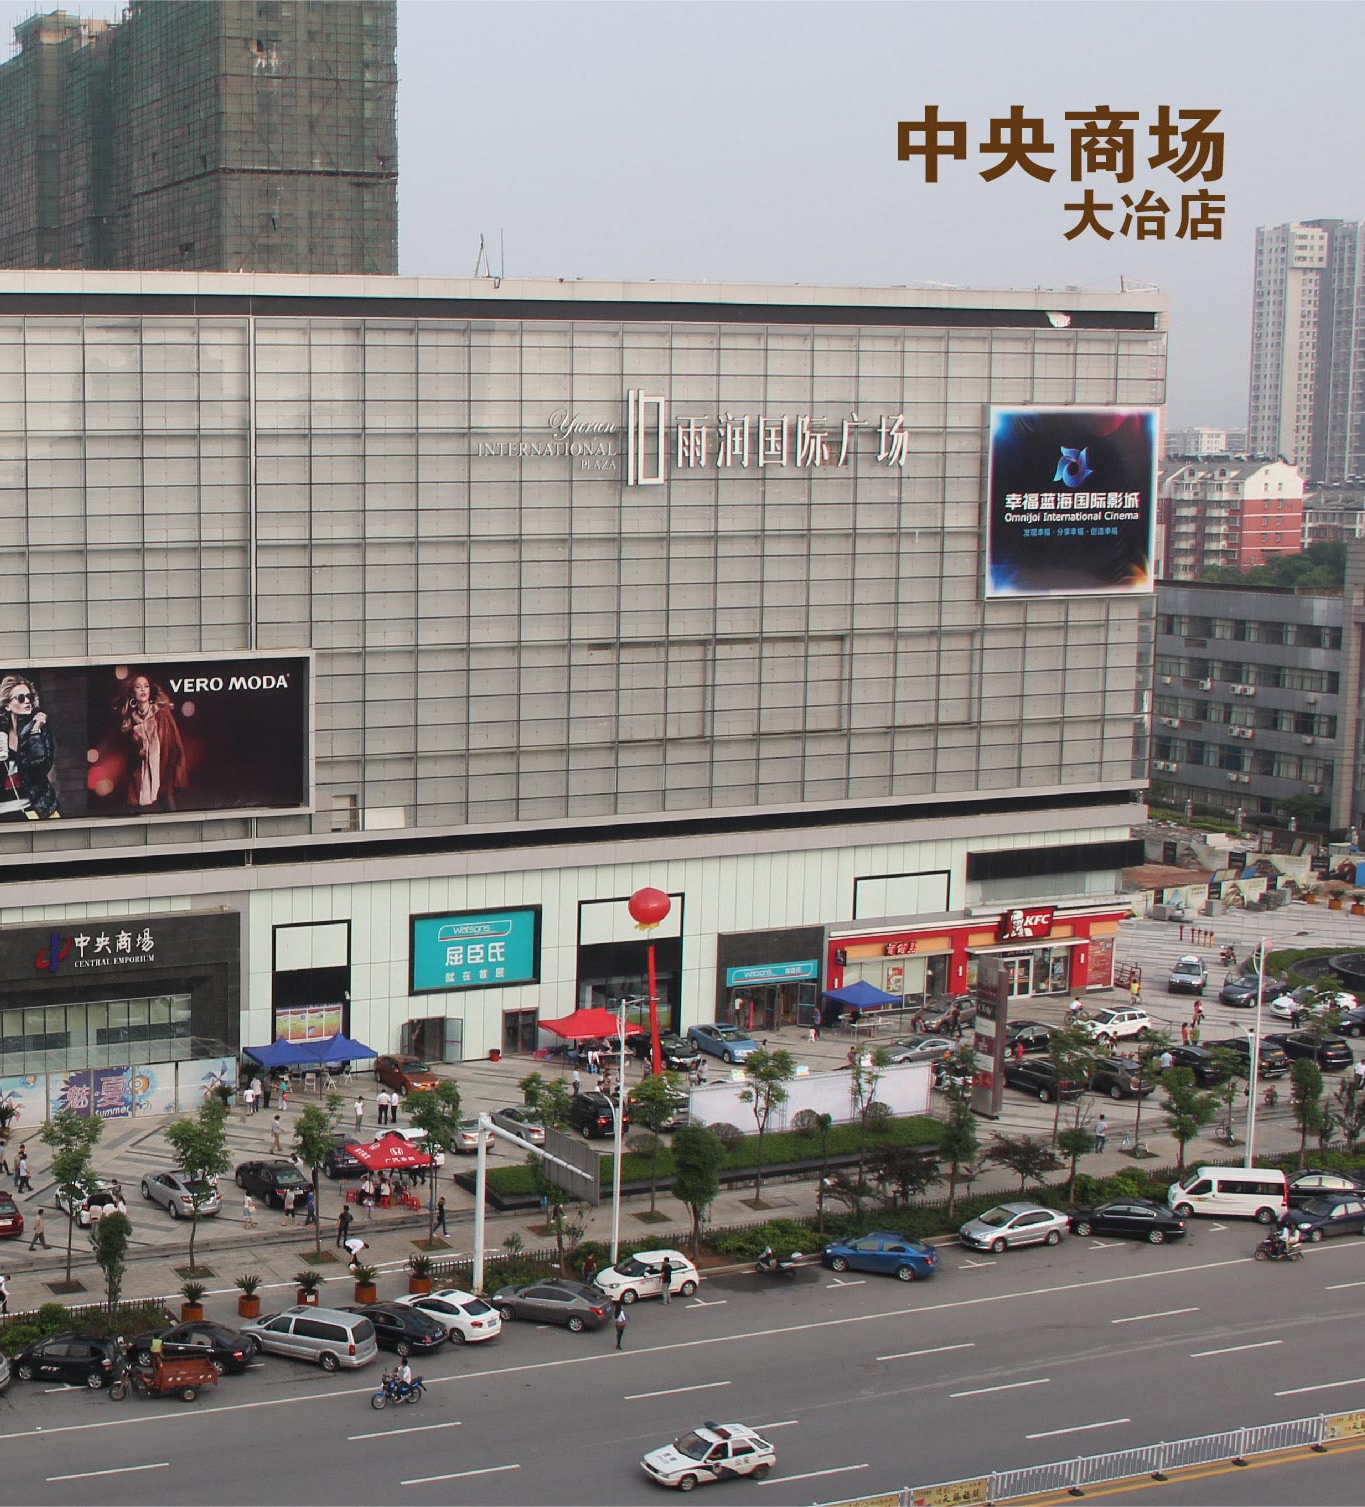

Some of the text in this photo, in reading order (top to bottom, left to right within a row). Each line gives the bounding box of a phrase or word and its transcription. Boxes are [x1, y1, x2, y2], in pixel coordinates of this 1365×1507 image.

[549, 409, 616, 441] Yurun
[677, 412, 908, 467] 雨润国际广场
[478, 442, 616, 457] INTERNATIONAL
[581, 460, 616, 470] PLAZA
[1005, 492, 1140, 510] 幸福蓝海国际影城
[1043, 512, 1101, 522] International
[1104, 511, 1139, 520] Cinema
[170, 675, 288, 693] VERO MODA
[1024, 914, 1051, 926] KFC
[74, 927, 154, 958] 中央商場
[75, 954, 154, 968] CENTRAL EMPORIUM
[445, 942, 505, 966] 屈臣氏
